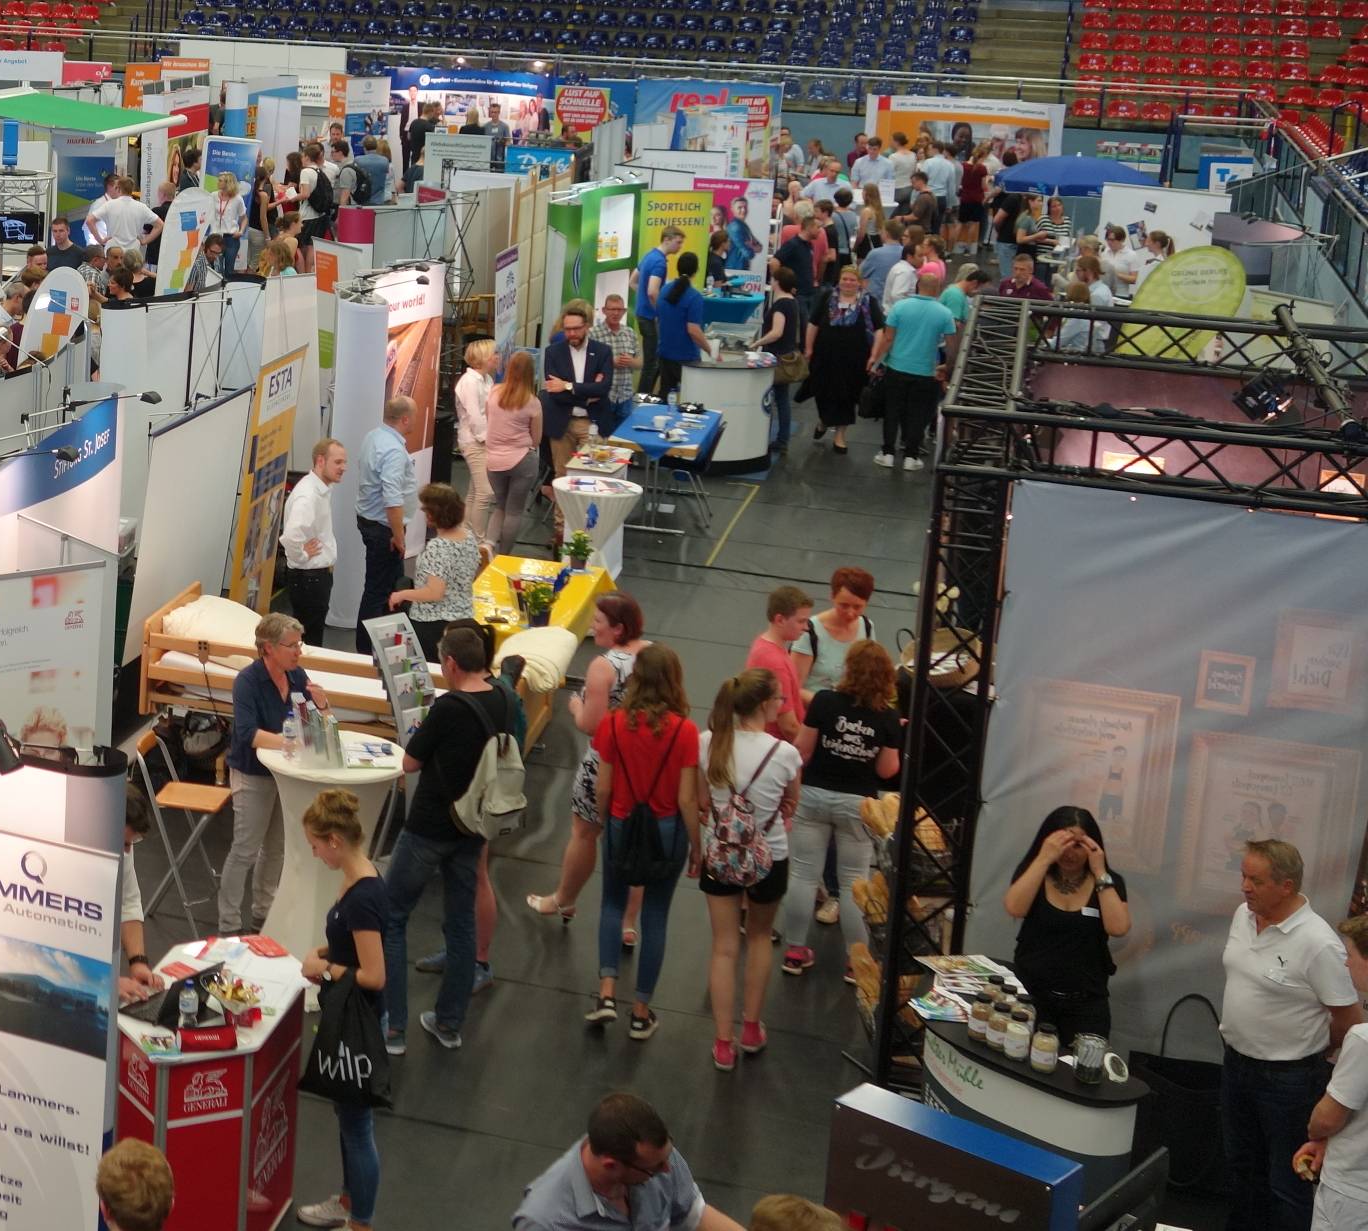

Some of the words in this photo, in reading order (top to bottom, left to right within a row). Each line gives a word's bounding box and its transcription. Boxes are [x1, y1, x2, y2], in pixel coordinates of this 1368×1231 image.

[560, 97, 602, 108] SCHNELLE
[564, 89, 583, 97] LUST
[584, 89, 600, 97] AUF
[401, 292, 426, 310] world!
[268, 364, 293, 399] ESTA
[3, 902, 103, 937] Automation.
[318, 1040, 374, 1090] wilp
[182, 1096, 229, 1114] GENERALI
[13, 1124, 34, 1140] es
[38, 1132, 91, 1156] willst!
